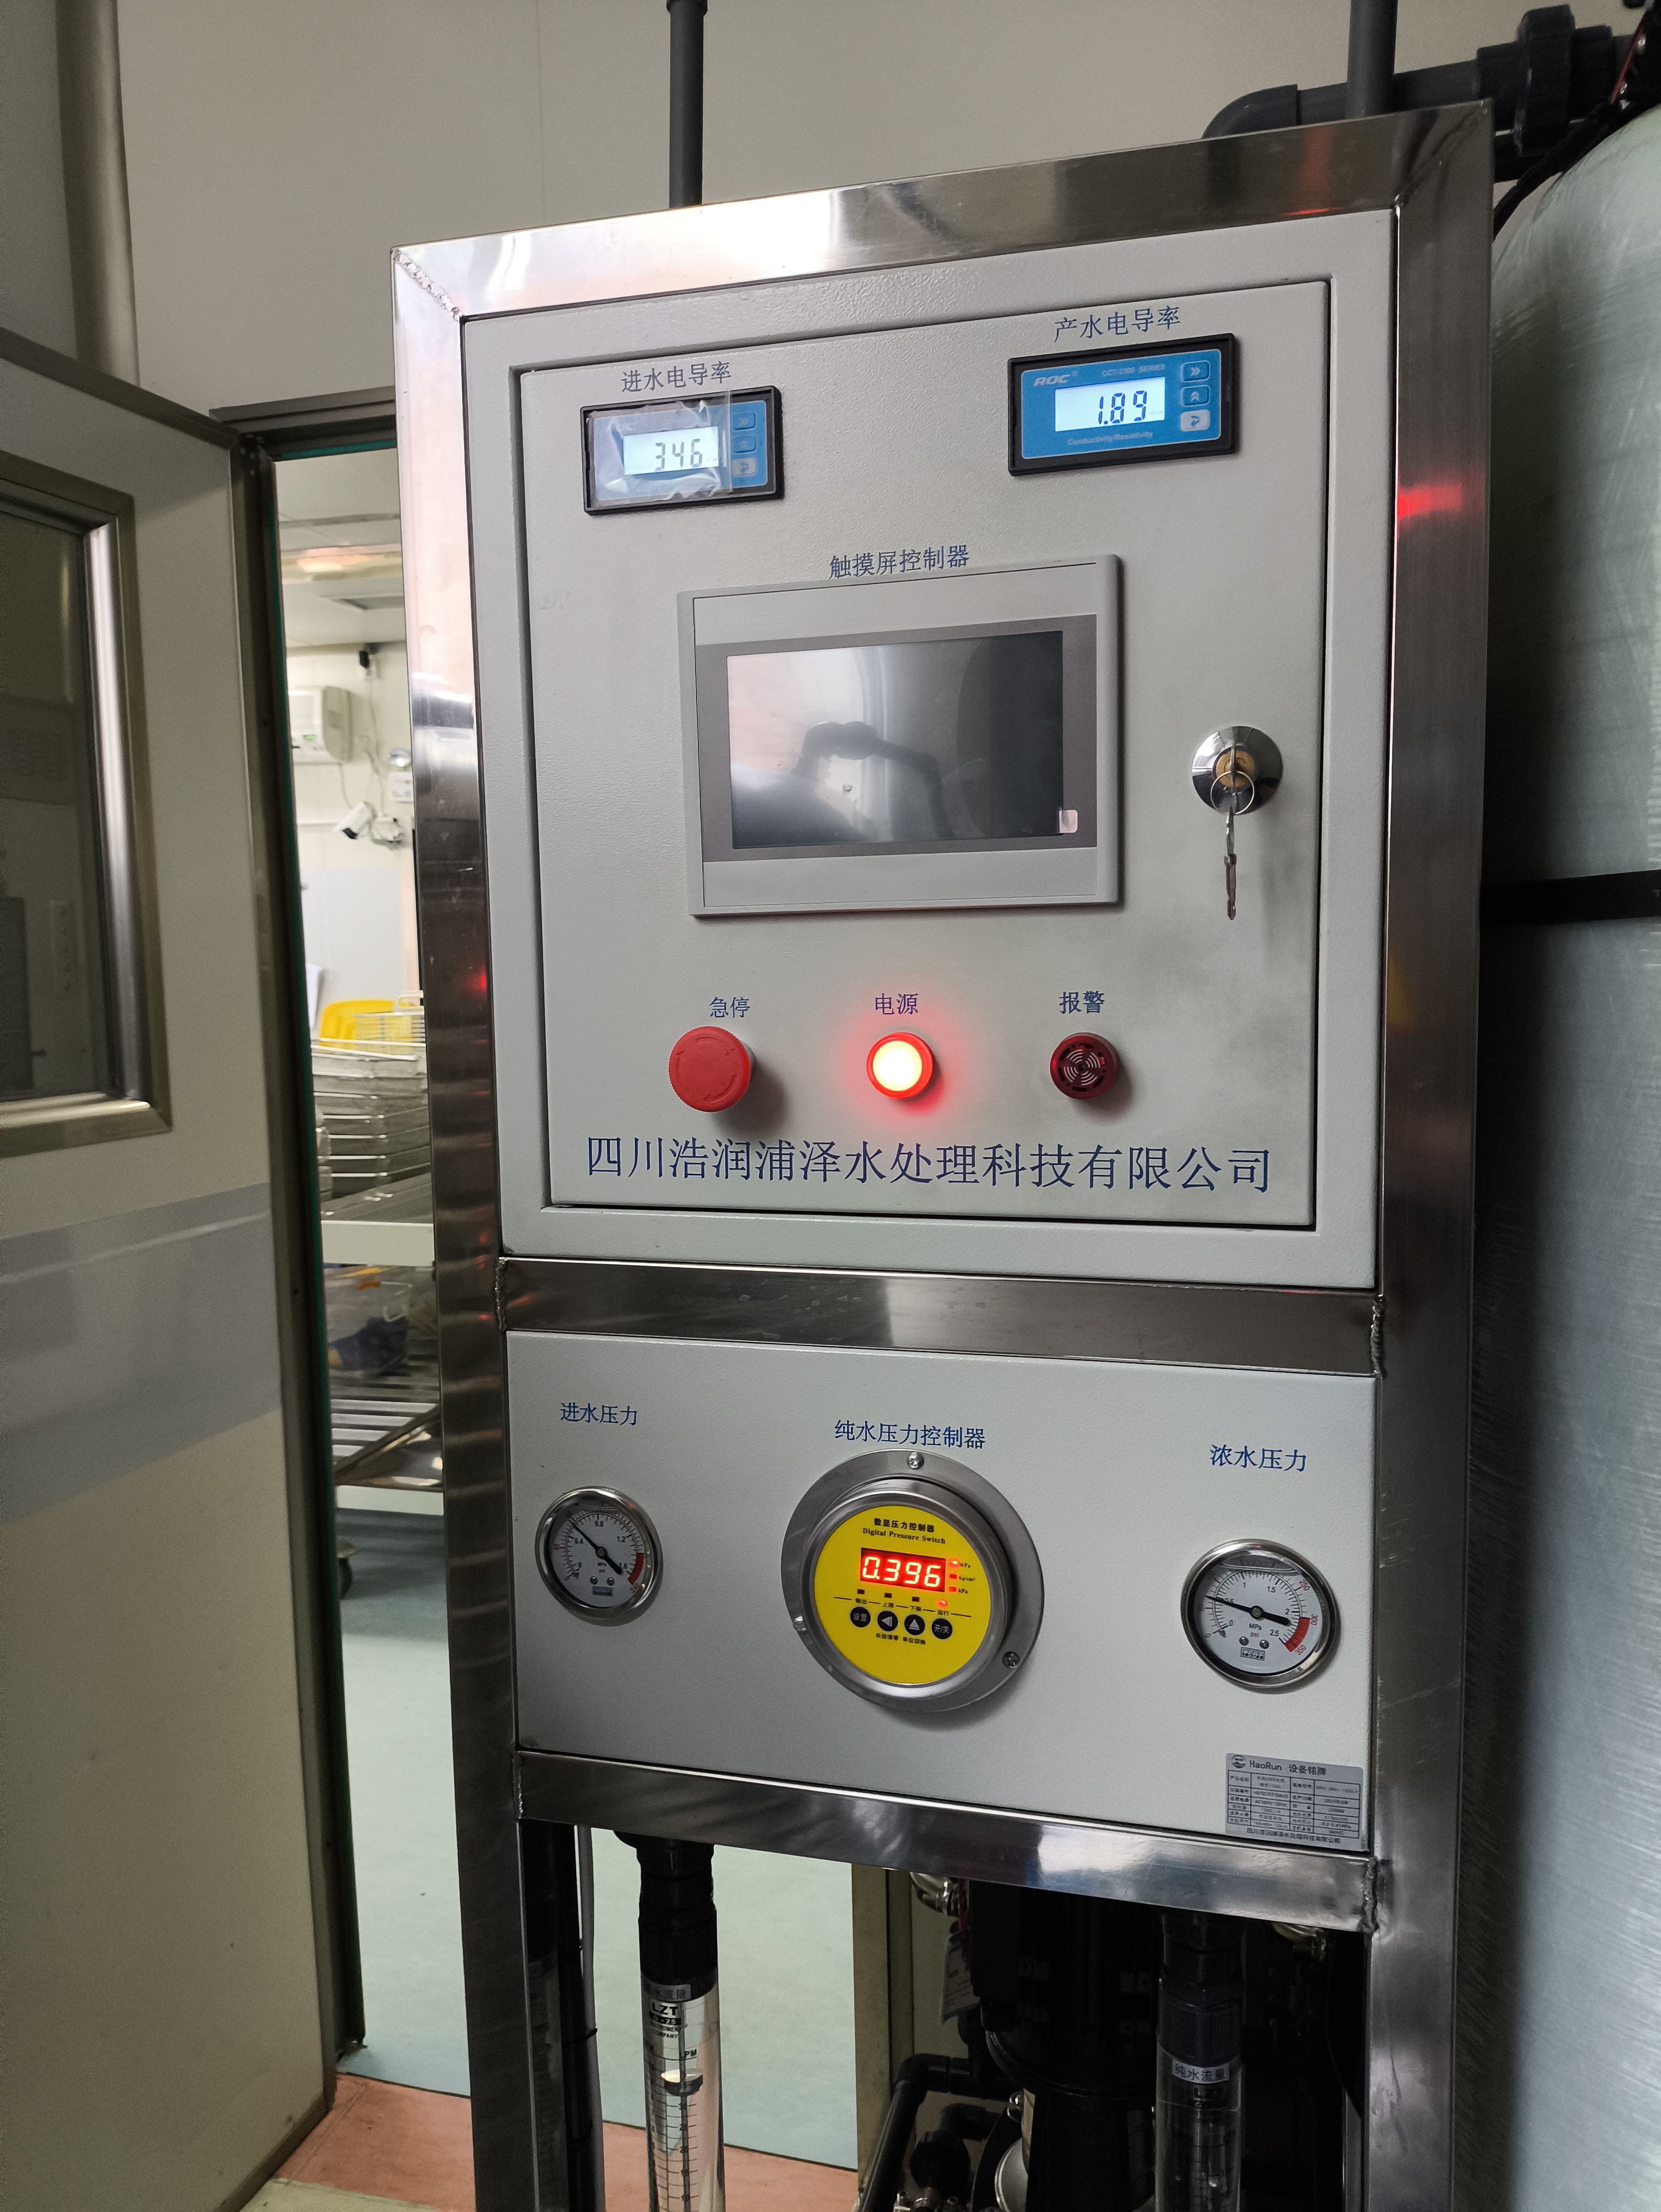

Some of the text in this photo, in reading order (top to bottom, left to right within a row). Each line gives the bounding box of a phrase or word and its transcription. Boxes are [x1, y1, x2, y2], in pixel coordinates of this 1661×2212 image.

[1054, 305, 1181, 343] 产水电导率
[621, 361, 731, 392] 进水电导率
[1033, 374, 1071, 387] ROC
[1098, 390, 1147, 425] 1.89
[654, 438, 703, 471] 346
[830, 544, 970, 579] 触摸屏控制器
[709, 996, 750, 1018] 急停
[875, 993, 919, 1015] 电源
[1059, 990, 1105, 1014] 报警
[586, 1136, 1272, 1194] 四川浩润浦泽水处理科技有限公司
[560, 1402, 637, 1426] 进水压力
[834, 1419, 986, 1449] 纯水压力控制器
[1209, 1444, 1307, 1472] 浓水压力
[863, 1527, 945, 1544] Digital Pressure Switch
[874, 1518, 934, 1533] 数显压力控制器
[862, 1556, 941, 1588] 0.396
[853, 1613, 867, 1622] 设置
[933, 1624, 950, 1634] 开/关
[1310, 1614, 1318, 1626] 300
[1249, 1759, 1282, 1771] HaoRun
[652, 2002, 678, 2016] LZT
[1174, 2063, 1225, 2082] 纯水流量
